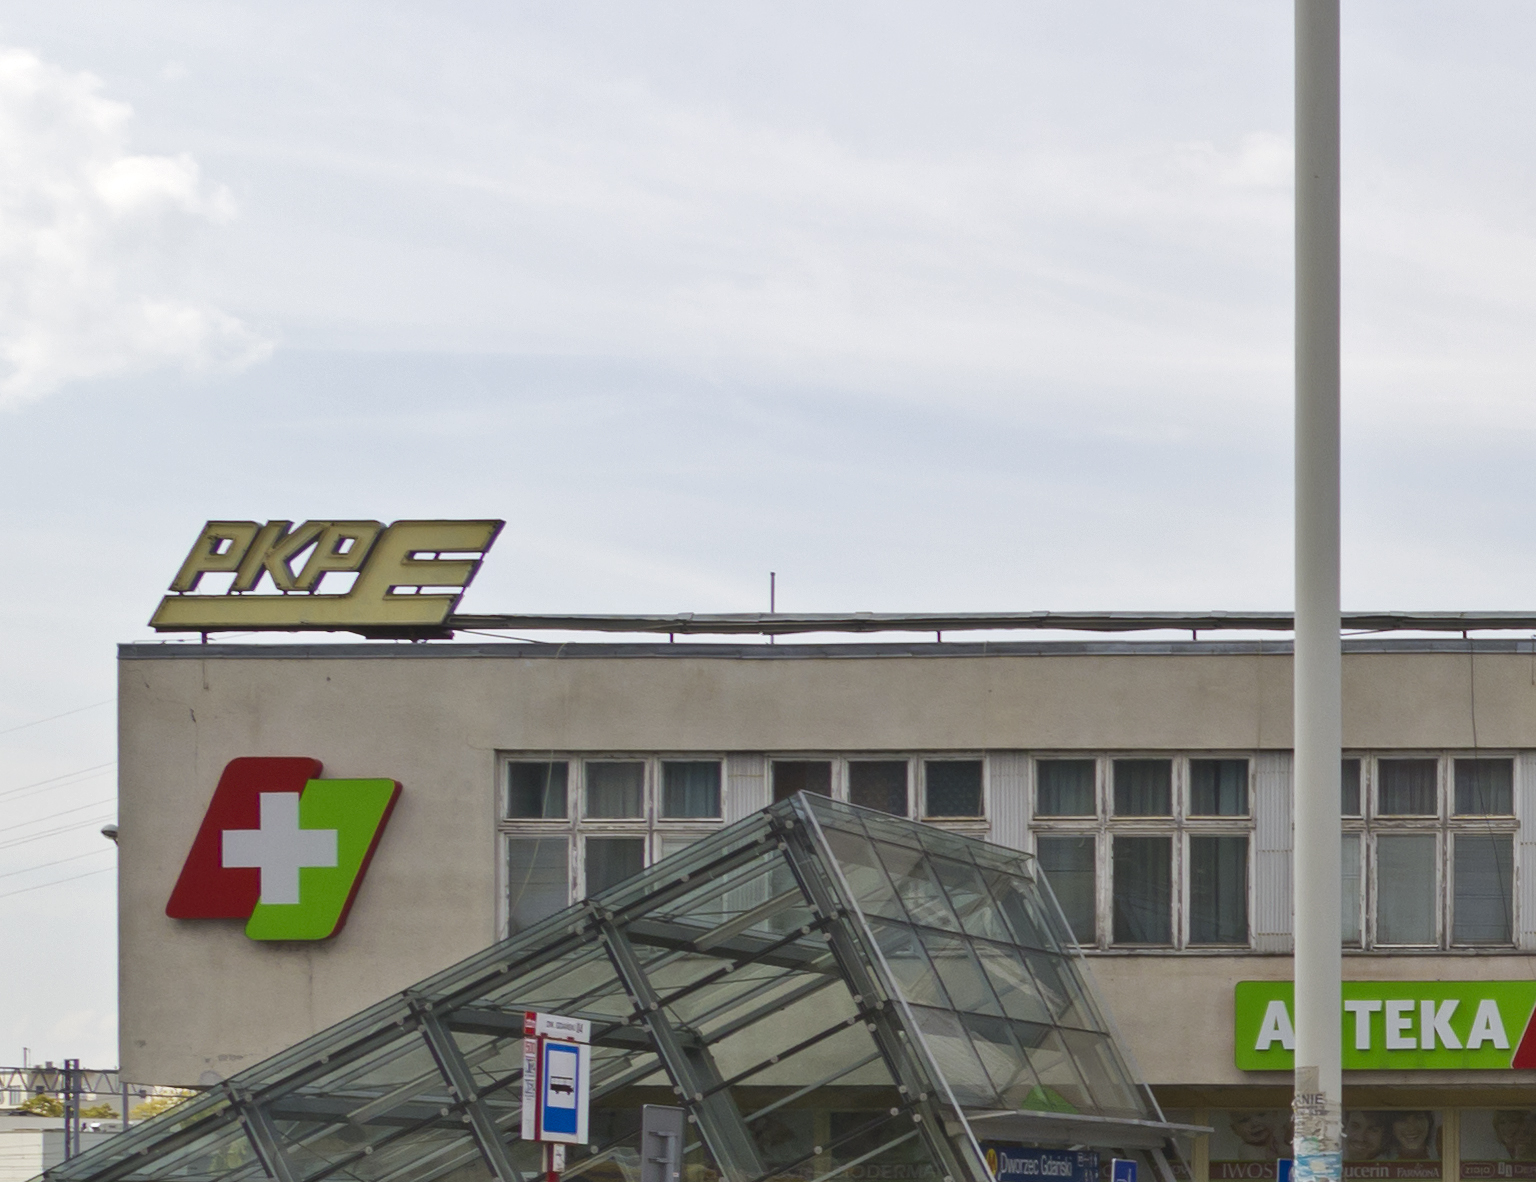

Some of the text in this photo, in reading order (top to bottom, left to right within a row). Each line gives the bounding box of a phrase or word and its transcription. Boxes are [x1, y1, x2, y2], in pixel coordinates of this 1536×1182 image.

[1254, 998, 1512, 1052] ATEKA
[1000, 1152, 1039, 1175] Dworzec
[1041, 1154, 1073, 1177] Gdański
[1222, 1162, 1275, 1179] IWOS
[1340, 1162, 1390, 1178] ucerin
